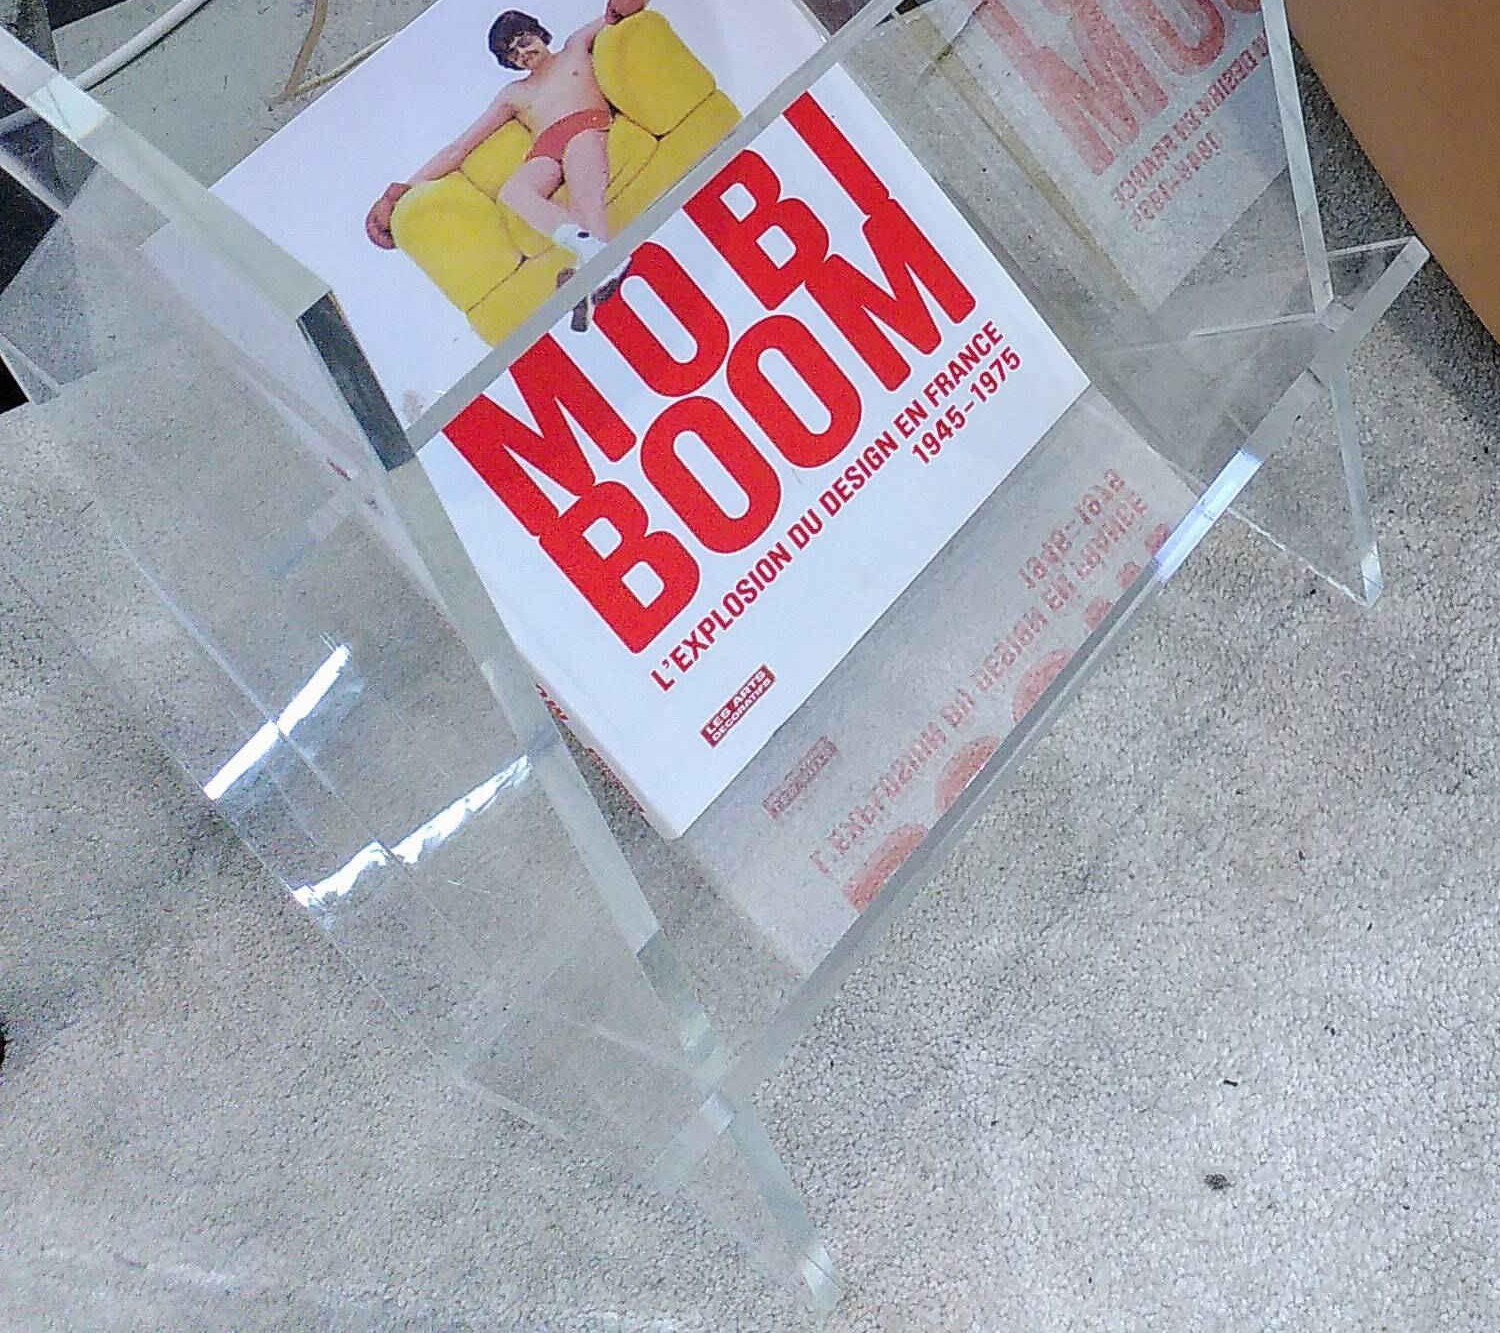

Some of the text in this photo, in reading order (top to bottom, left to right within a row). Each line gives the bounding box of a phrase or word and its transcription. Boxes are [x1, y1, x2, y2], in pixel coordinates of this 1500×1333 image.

[442, 90, 892, 537] MOBI
[538, 198, 978, 654] BOOM
[911, 346, 1021, 466] 1945-1975
[651, 320, 1004, 691] L'EXPLOSION DU DESIGN EN FRANCE
[705, 670, 767, 735] LES ARTS
